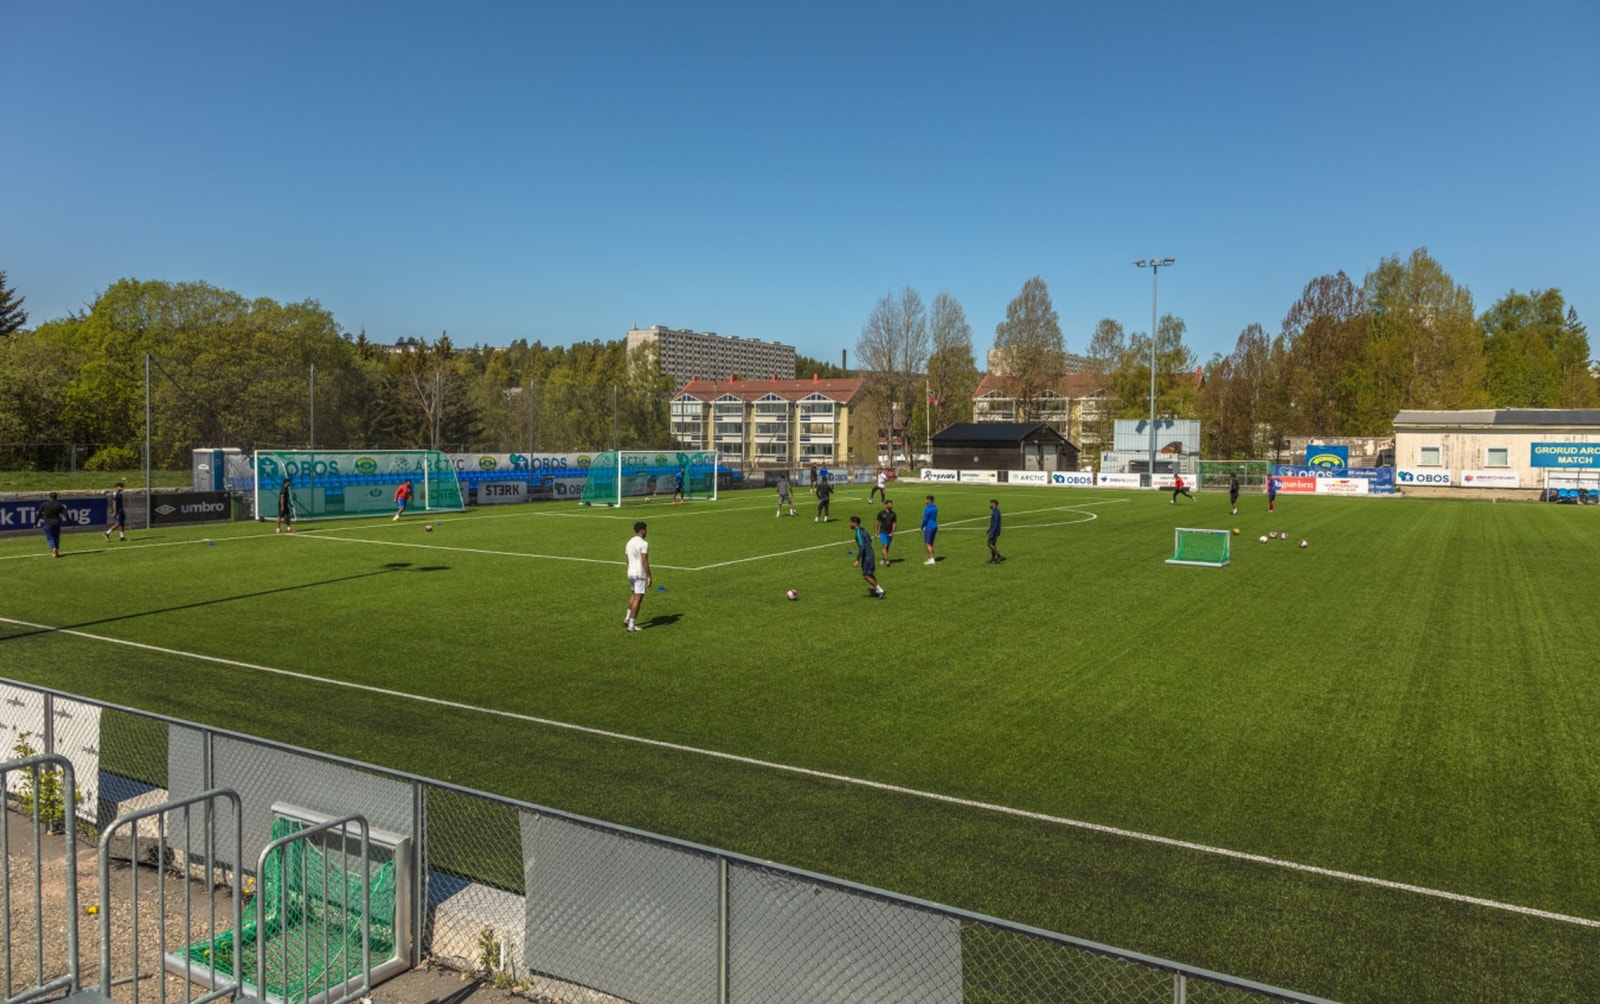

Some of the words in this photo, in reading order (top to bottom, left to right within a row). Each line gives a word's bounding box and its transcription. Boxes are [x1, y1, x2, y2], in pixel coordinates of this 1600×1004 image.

[1535, 446, 1578, 454] GRORUD
[532, 457, 567, 470] OBOS
[1558, 456, 1593, 464] MATCH
[284, 460, 340, 476] OBOS
[1066, 476, 1092, 484] OBOS
[1416, 474, 1450, 483] OBOS
[181, 501, 225, 513] umbro
